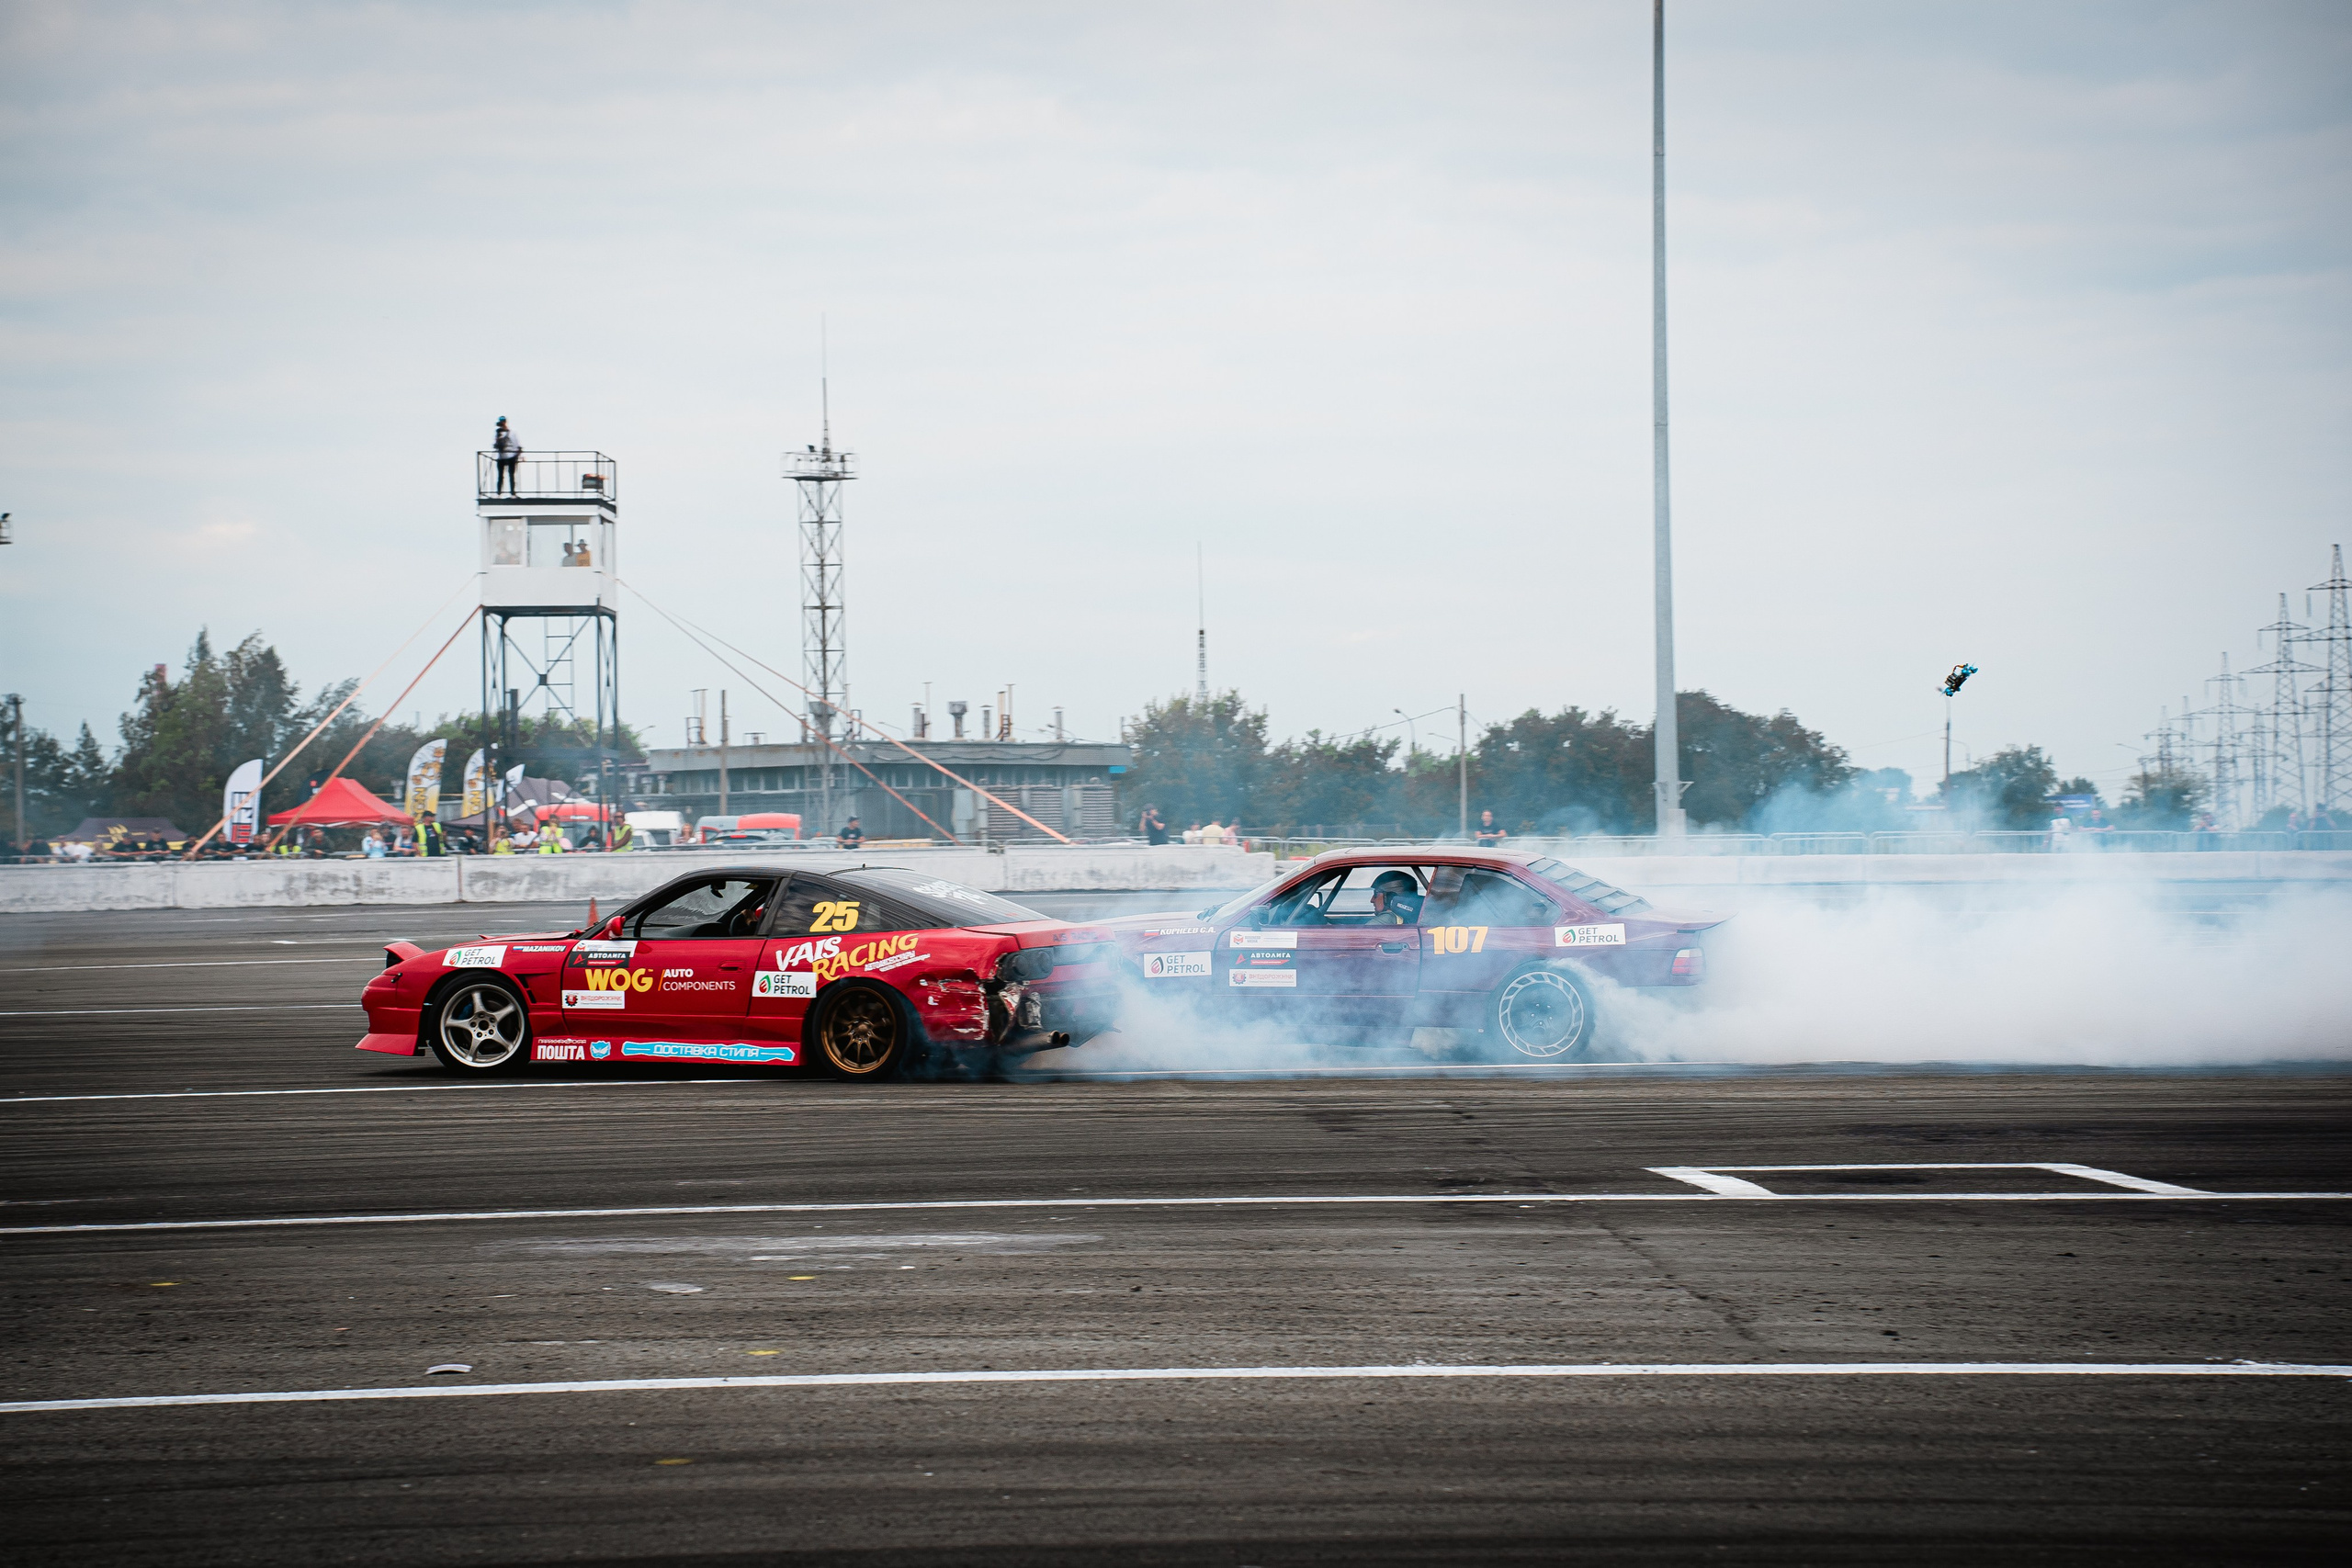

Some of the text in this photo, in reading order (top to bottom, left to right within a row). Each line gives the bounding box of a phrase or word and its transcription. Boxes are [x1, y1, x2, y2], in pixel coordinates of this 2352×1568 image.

[809, 901, 861, 932] 25
[1578, 927, 1598, 935] GET
[1427, 926, 1488, 955] 107
[1578, 934, 1619, 943] PETROL
[464, 948, 483, 957] GET
[775, 936, 842, 972] VAIS
[812, 933, 920, 982] RACING
[460, 956, 496, 965] PETROL
[1166, 955, 1186, 964] GET
[663, 968, 694, 978] AUTO
[1167, 964, 1205, 974] PETROL
[584, 967, 653, 993] WOG
[774, 975, 792, 984] GET
[662, 980, 736, 991] COMPONENTS
[774, 985, 810, 995] PETROL
[537, 1045, 585, 1060] ПОШТА
[653, 1044, 760, 1057] ДОСТАВКА СТИЛЯ
